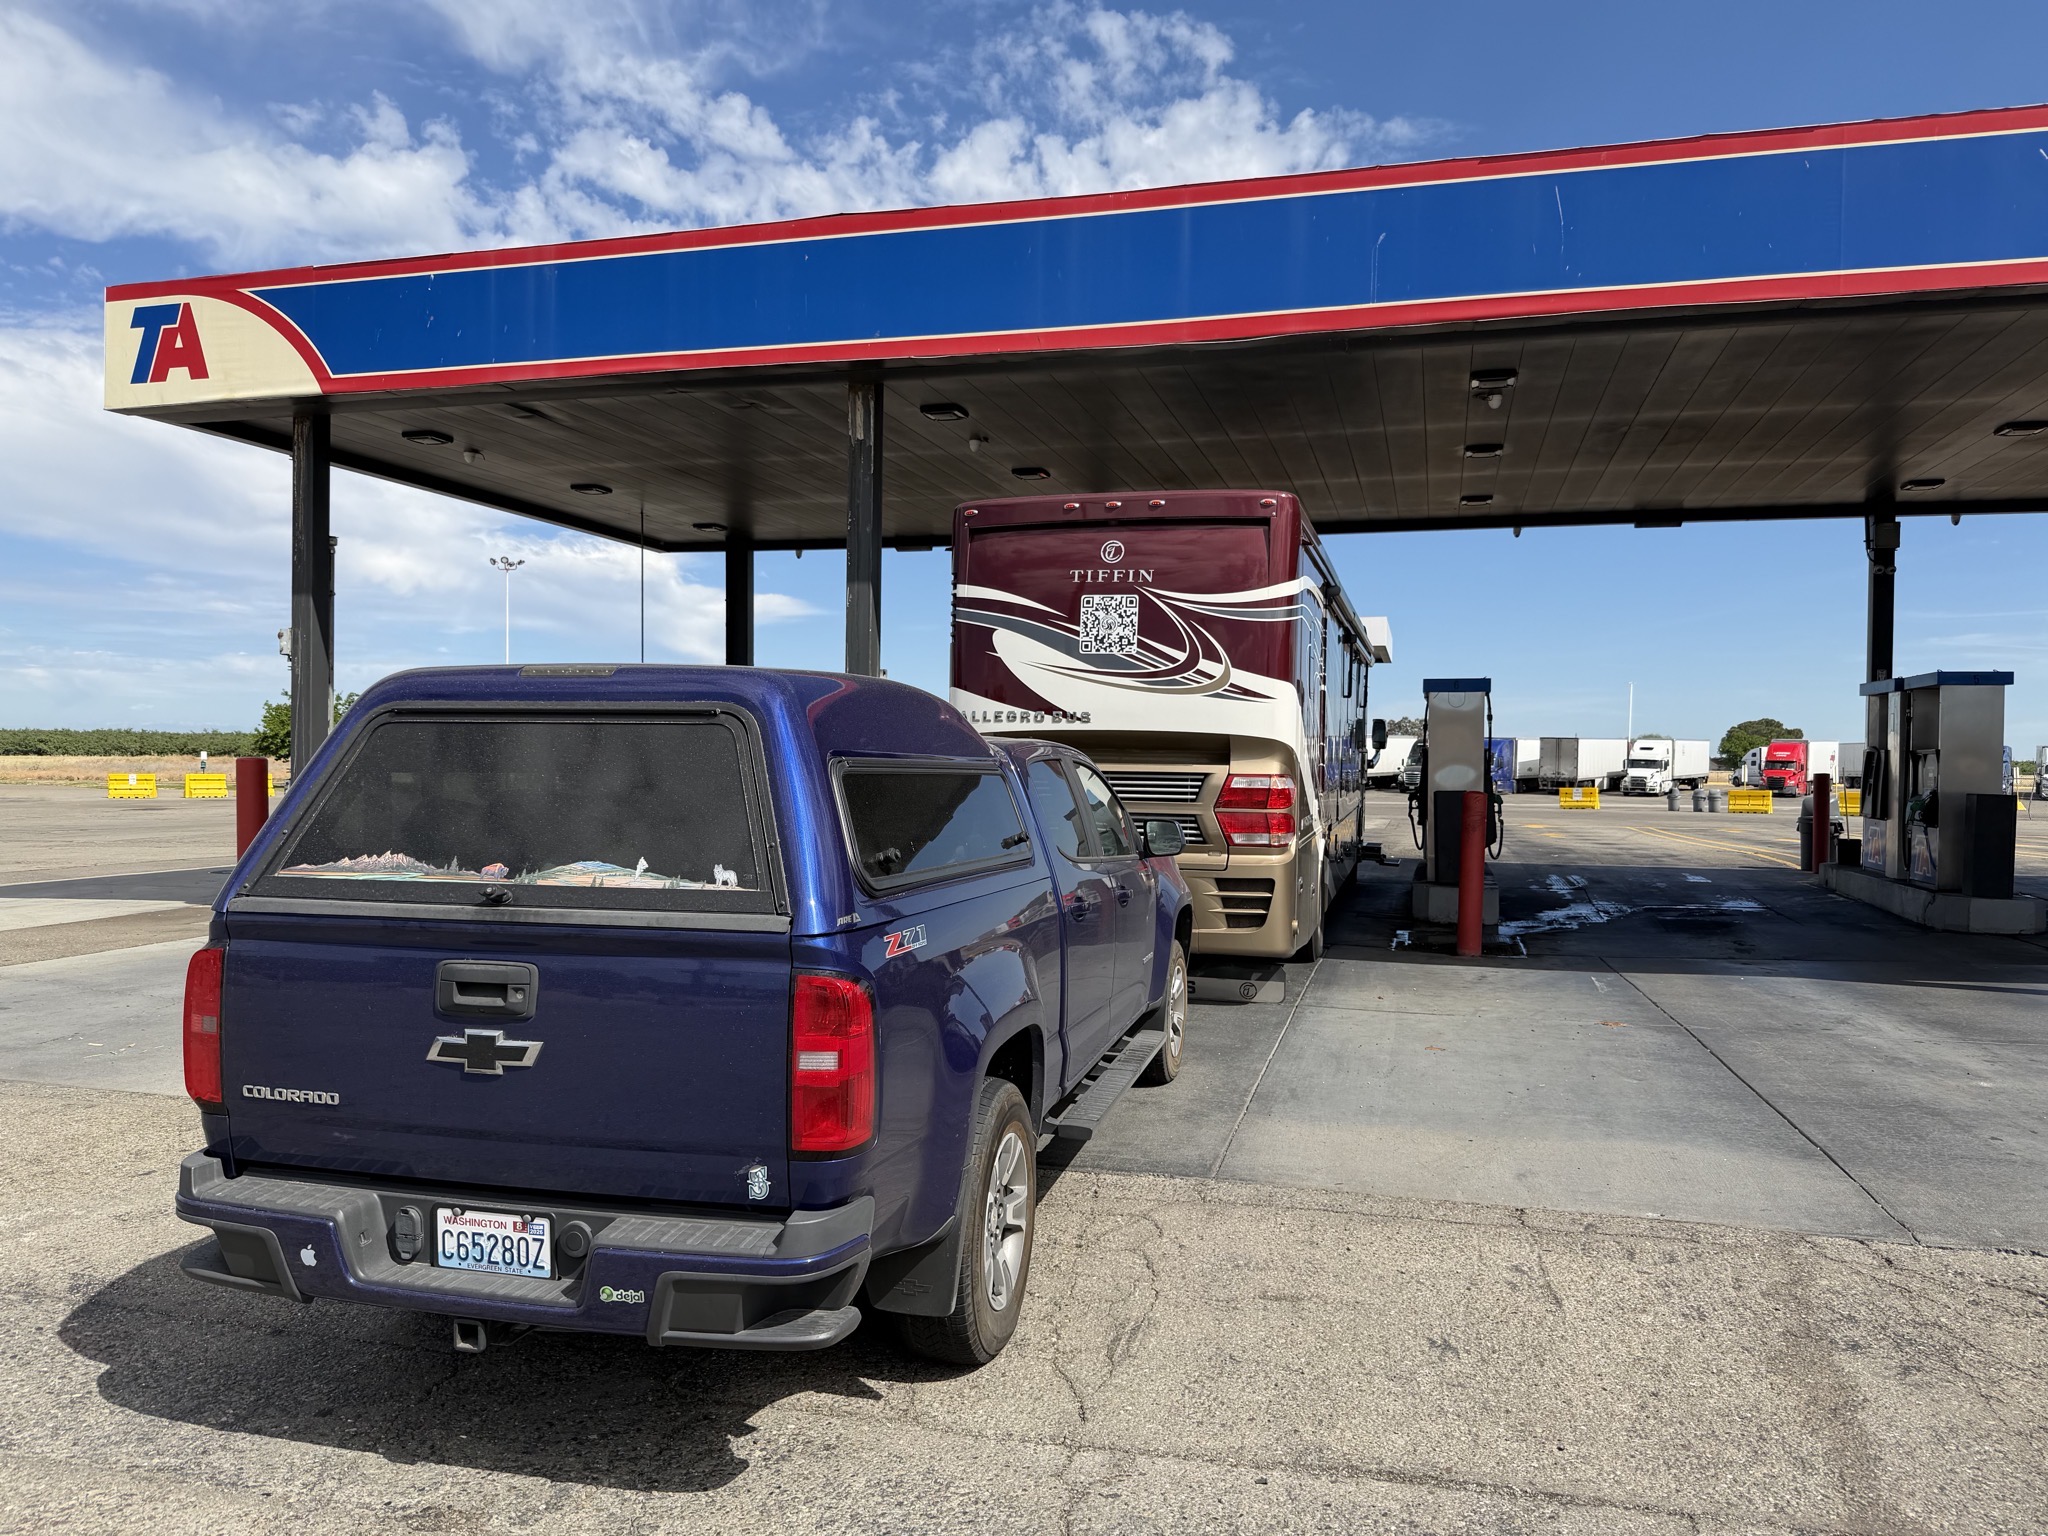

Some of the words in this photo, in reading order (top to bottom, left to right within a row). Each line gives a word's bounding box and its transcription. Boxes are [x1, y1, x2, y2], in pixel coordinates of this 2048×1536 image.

[130, 302, 209, 384] TA
[1069, 569, 1154, 583] TIFFIN
[1052, 711, 1091, 724] BUS
[1868, 826, 1882, 865] TA
[883, 924, 927, 959] Z71
[243, 1085, 340, 1105] COLORADO
[443, 1215, 508, 1230] WASHINGTON
[442, 1229, 545, 1270] C65280Z
[467, 1263, 502, 1272] EVERGREEN
[505, 1267, 523, 1275] STATE
[616, 1291, 643, 1303] dejal
